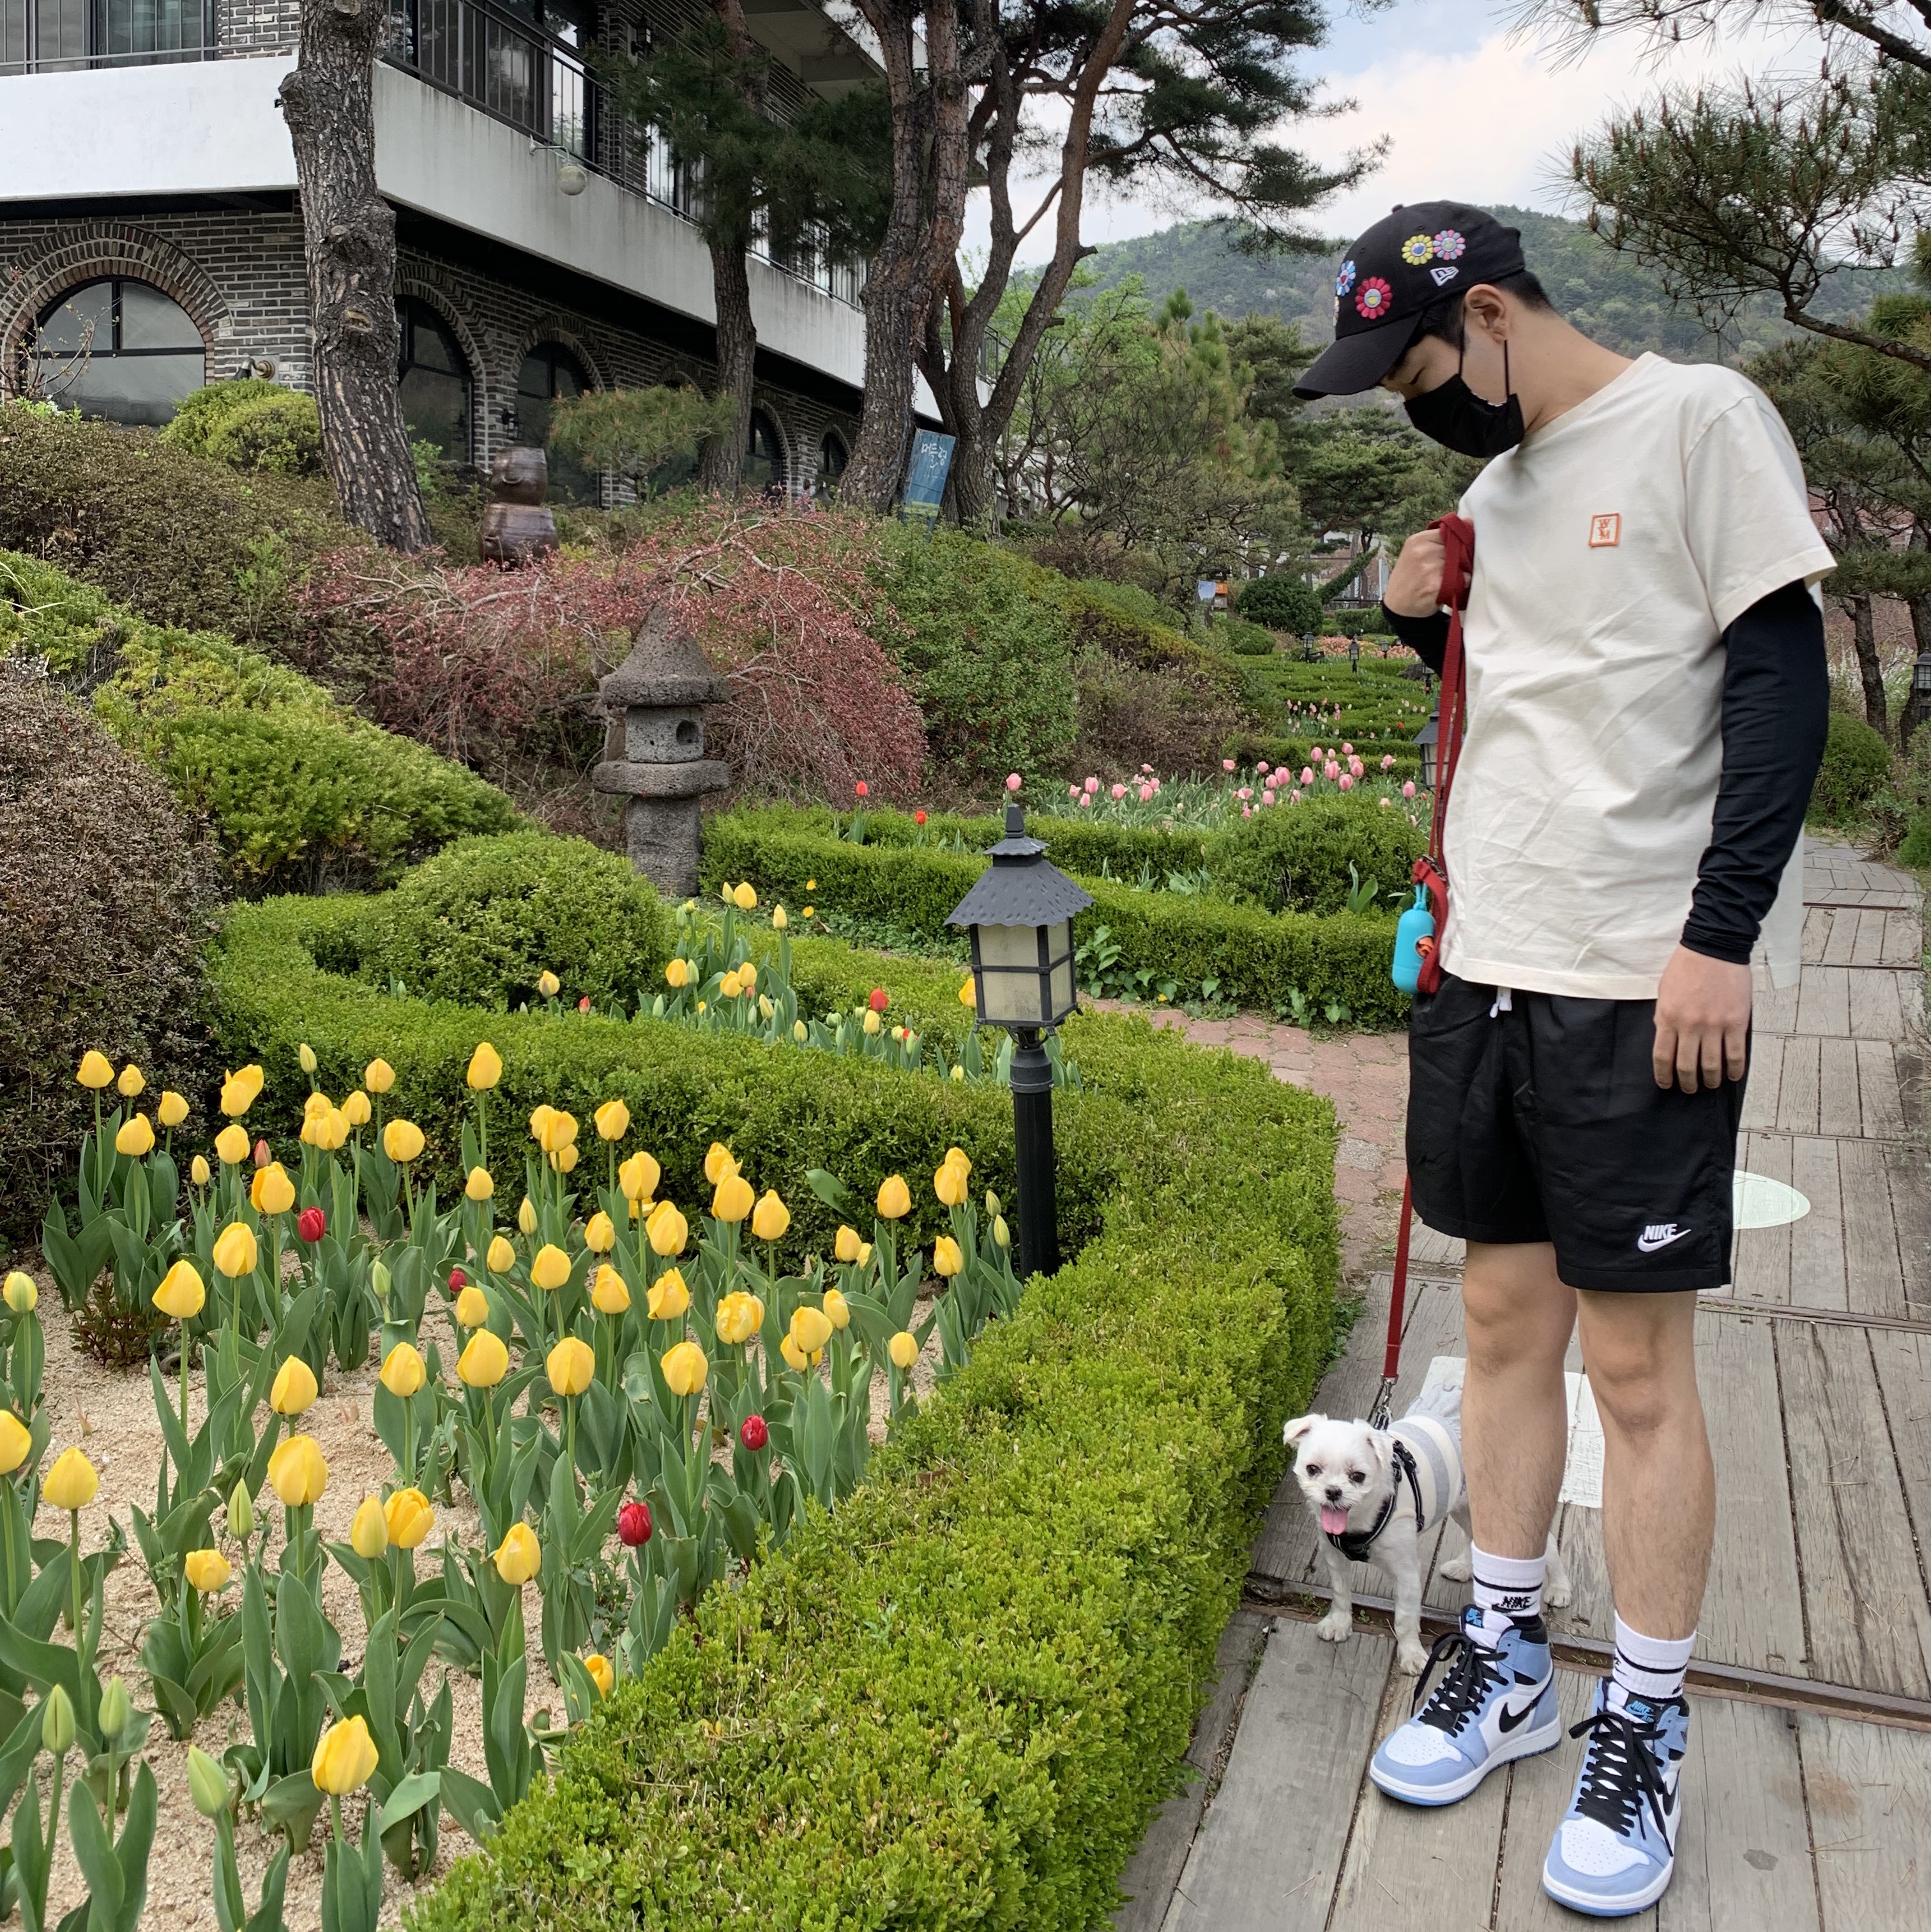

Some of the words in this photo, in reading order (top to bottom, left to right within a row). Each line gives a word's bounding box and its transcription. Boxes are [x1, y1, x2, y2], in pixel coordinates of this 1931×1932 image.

[1643, 1224, 1677, 1240] NIKE
[1501, 1595, 1531, 1608] NIKE
[1631, 1700, 1652, 1714] NIKE
